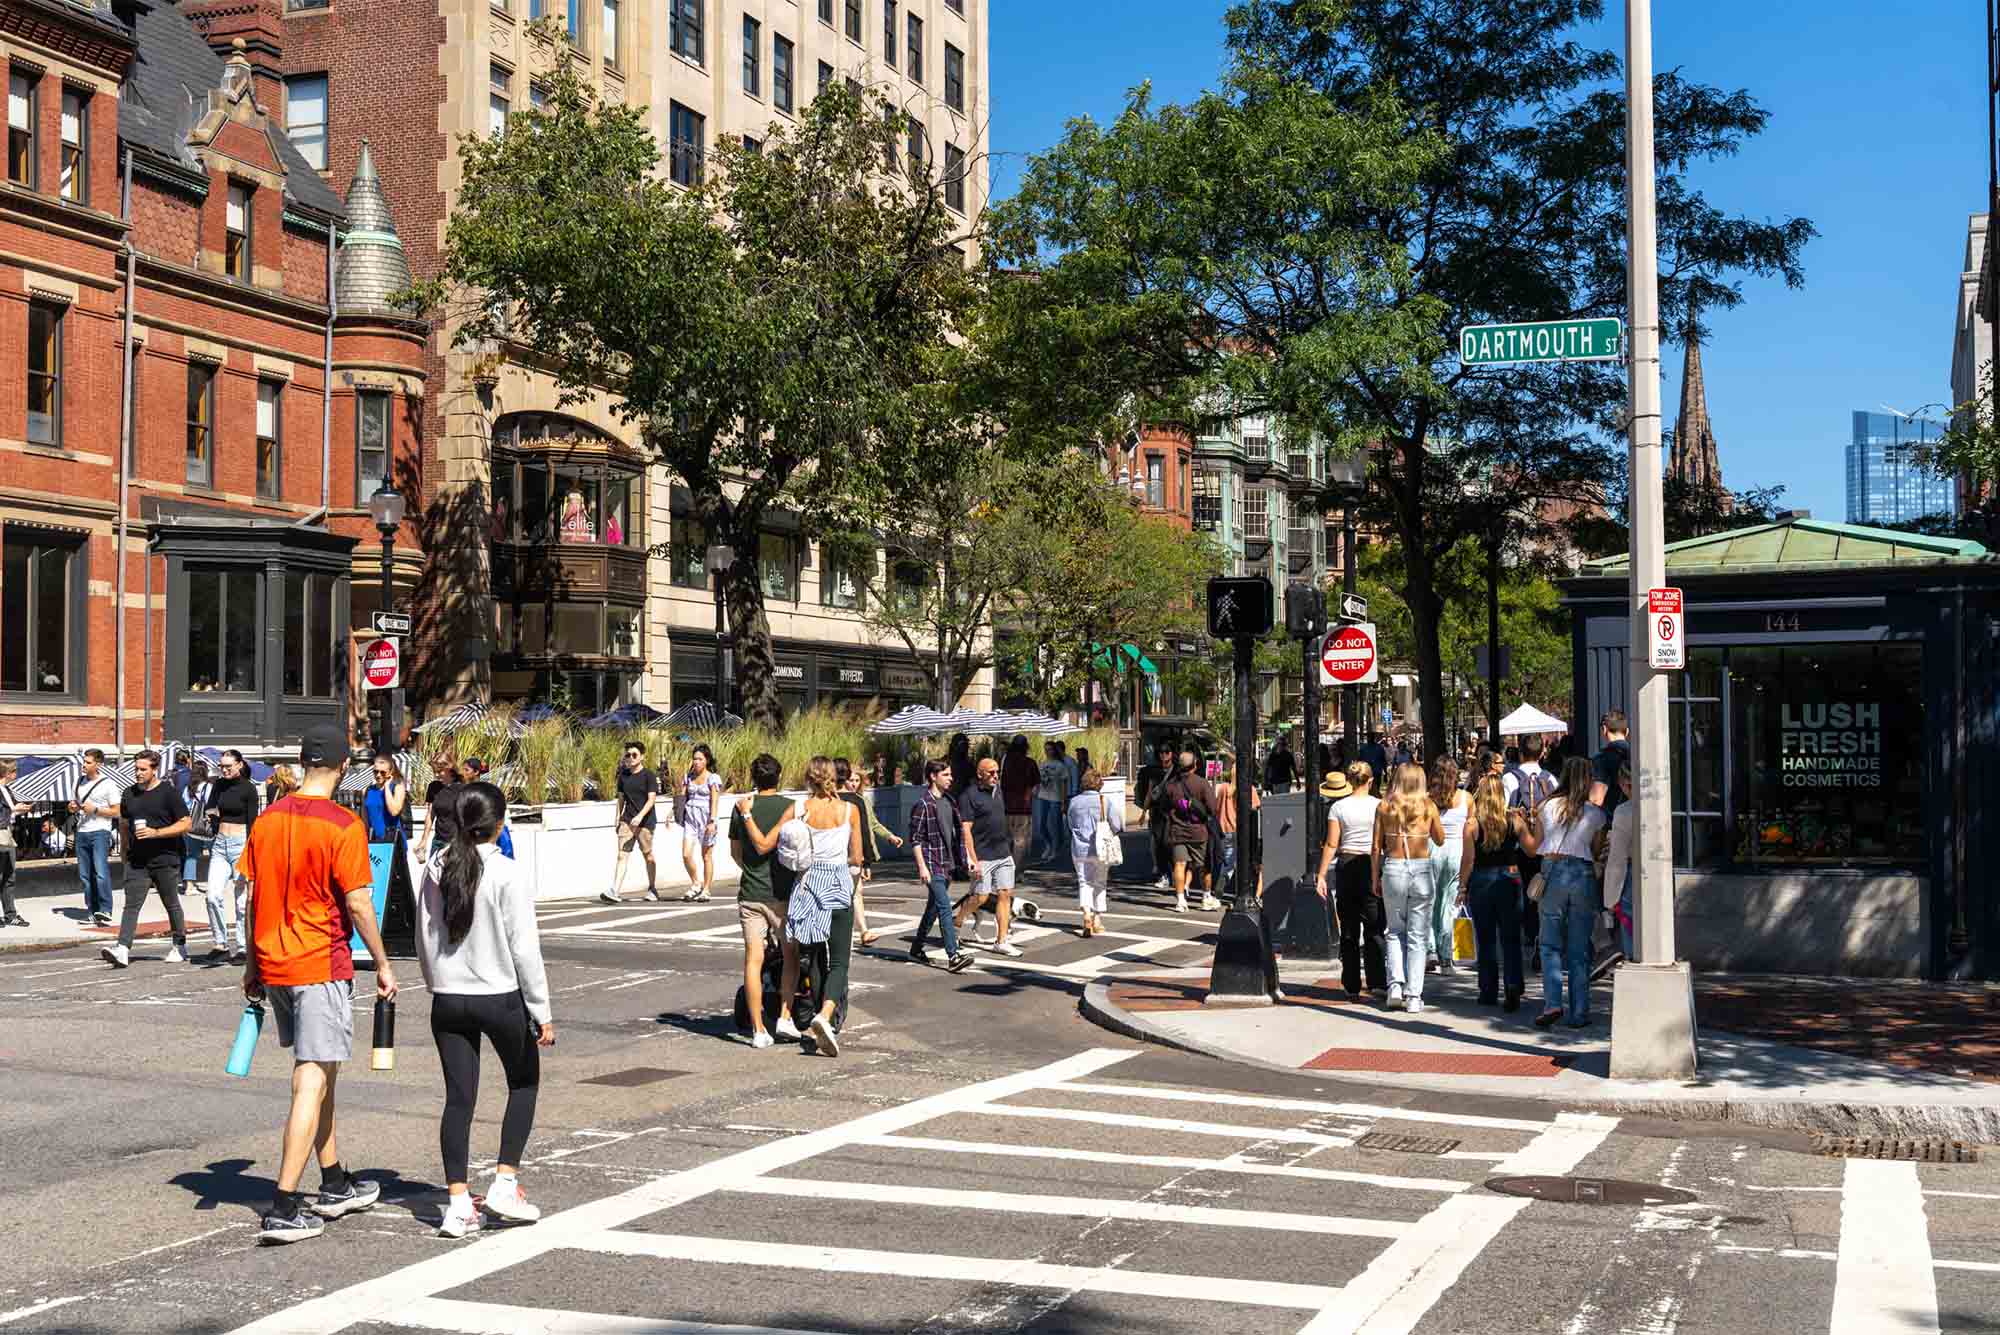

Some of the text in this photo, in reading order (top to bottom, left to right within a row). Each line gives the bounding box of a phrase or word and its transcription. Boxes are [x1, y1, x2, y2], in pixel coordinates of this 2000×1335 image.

[1464, 326, 1618, 361] DARTMOUTH ST
[1651, 591, 1679, 600] TOW ZONE
[1766, 613, 1800, 631] 144
[1328, 638, 1367, 649] DO NOT
[380, 649, 393, 657] NOT
[1658, 648, 1677, 657] SNOW
[1331, 661, 1365, 671] ENTER
[370, 669, 392, 677] ENTER
[1781, 702, 1880, 729] LUSH
[1781, 731, 1880, 754] FRESH
[1782, 757, 1880, 770] HANDMADE
[1783, 774, 1881, 787] COSMETICS
